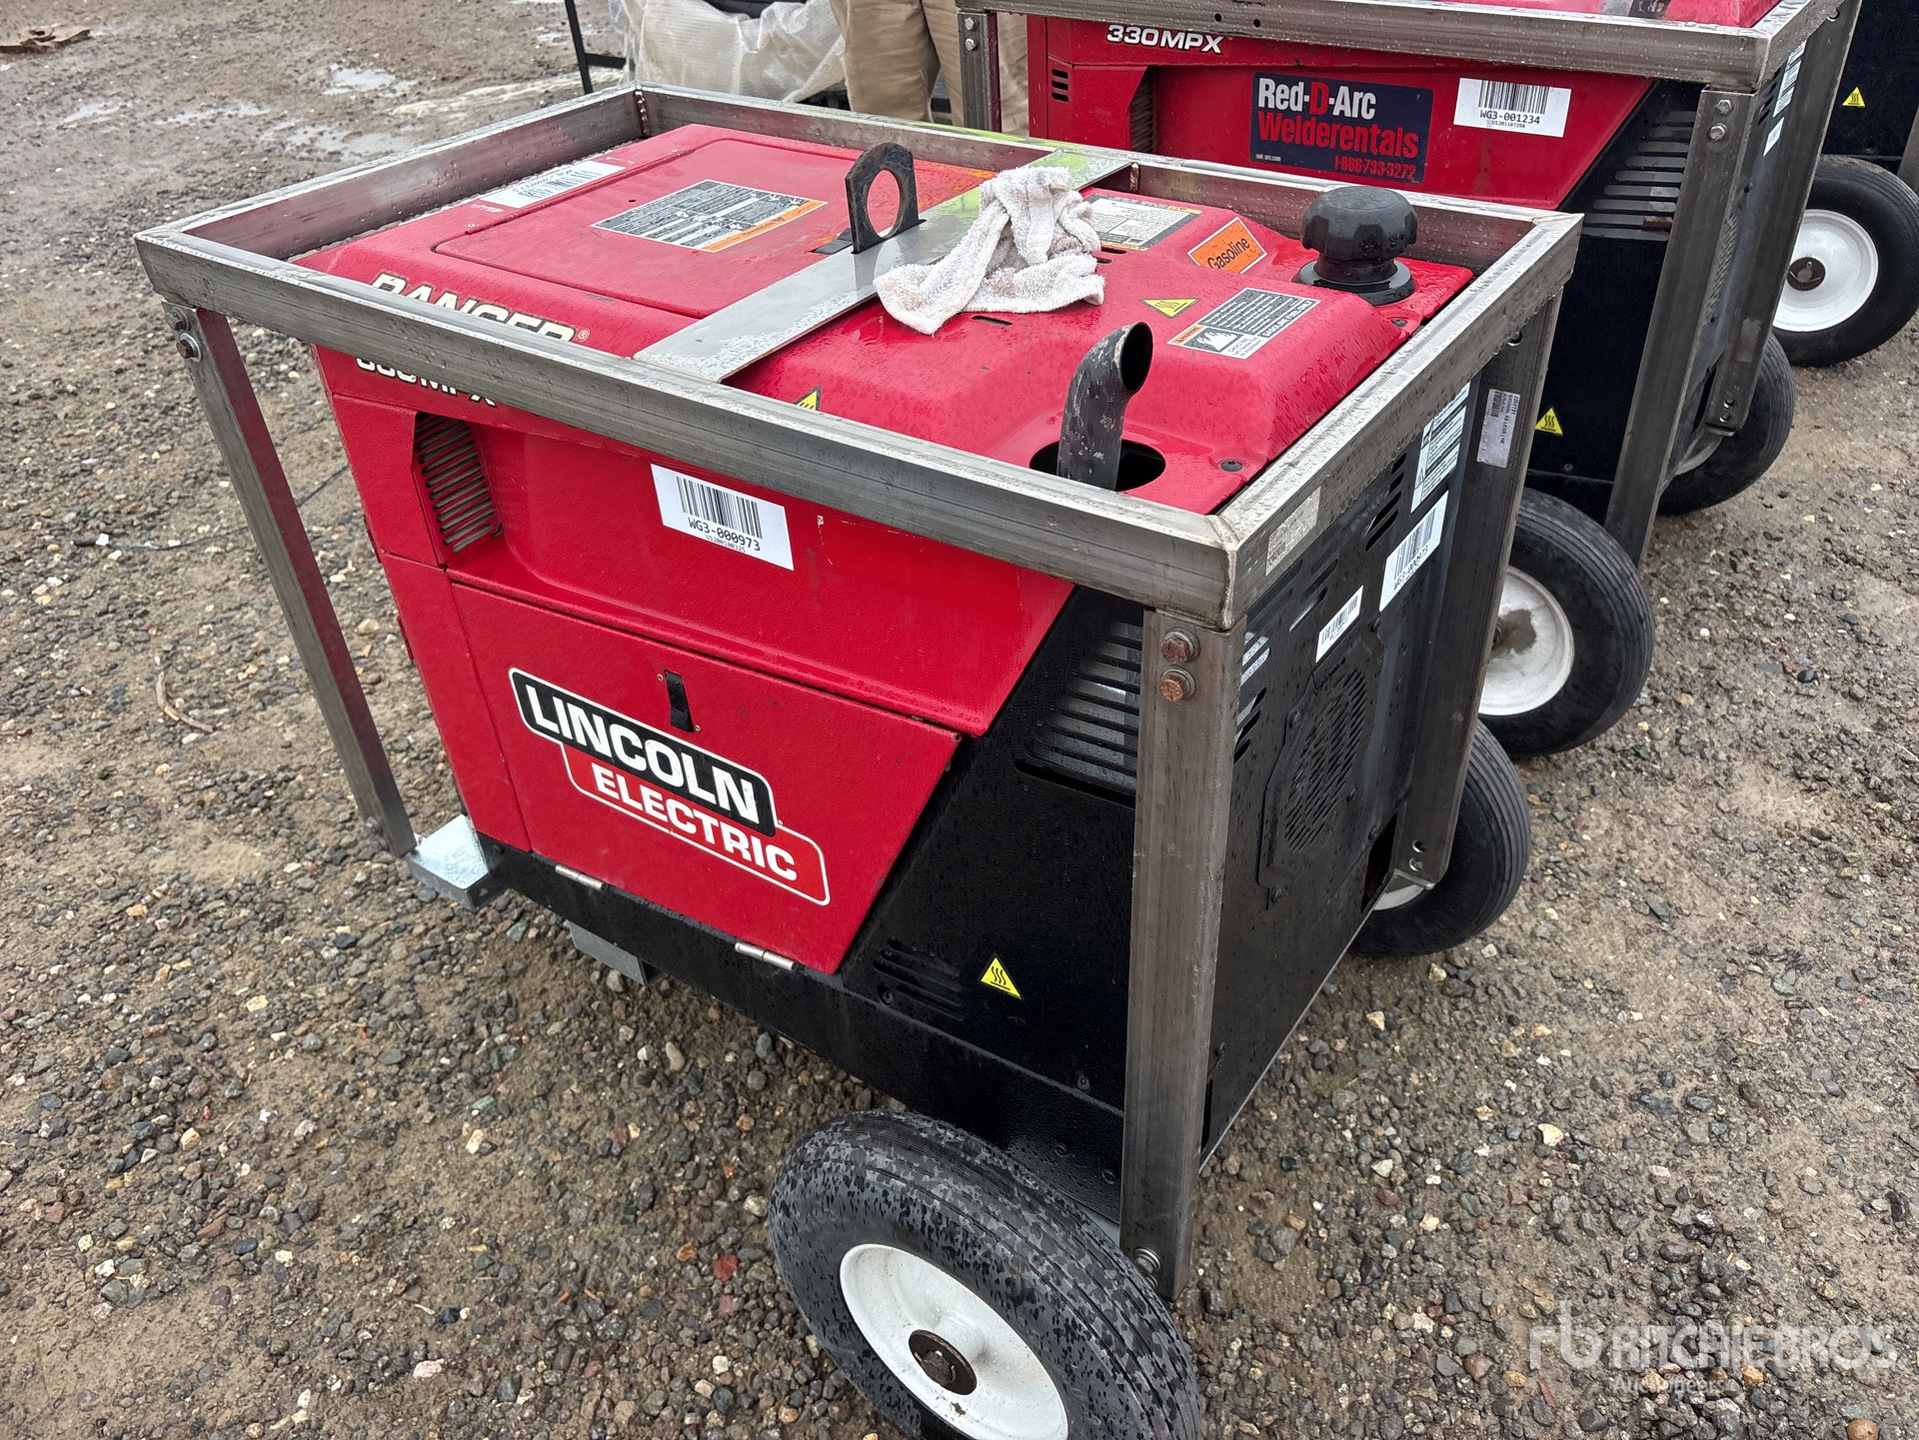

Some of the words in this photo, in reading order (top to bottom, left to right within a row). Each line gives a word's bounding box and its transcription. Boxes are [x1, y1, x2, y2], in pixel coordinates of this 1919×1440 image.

[1107, 24, 1224, 54] 330MPX
[1258, 77, 1376, 120] Red-D-Arc
[1480, 110, 1540, 125] WG3-001234
[1258, 111, 1419, 159] Welderentals
[1207, 238, 1250, 270] Gasoline
[688, 517, 761, 551] WG3-000973
[525, 684, 761, 824] LINCOLN
[591, 762, 797, 881] ELECTRIC
